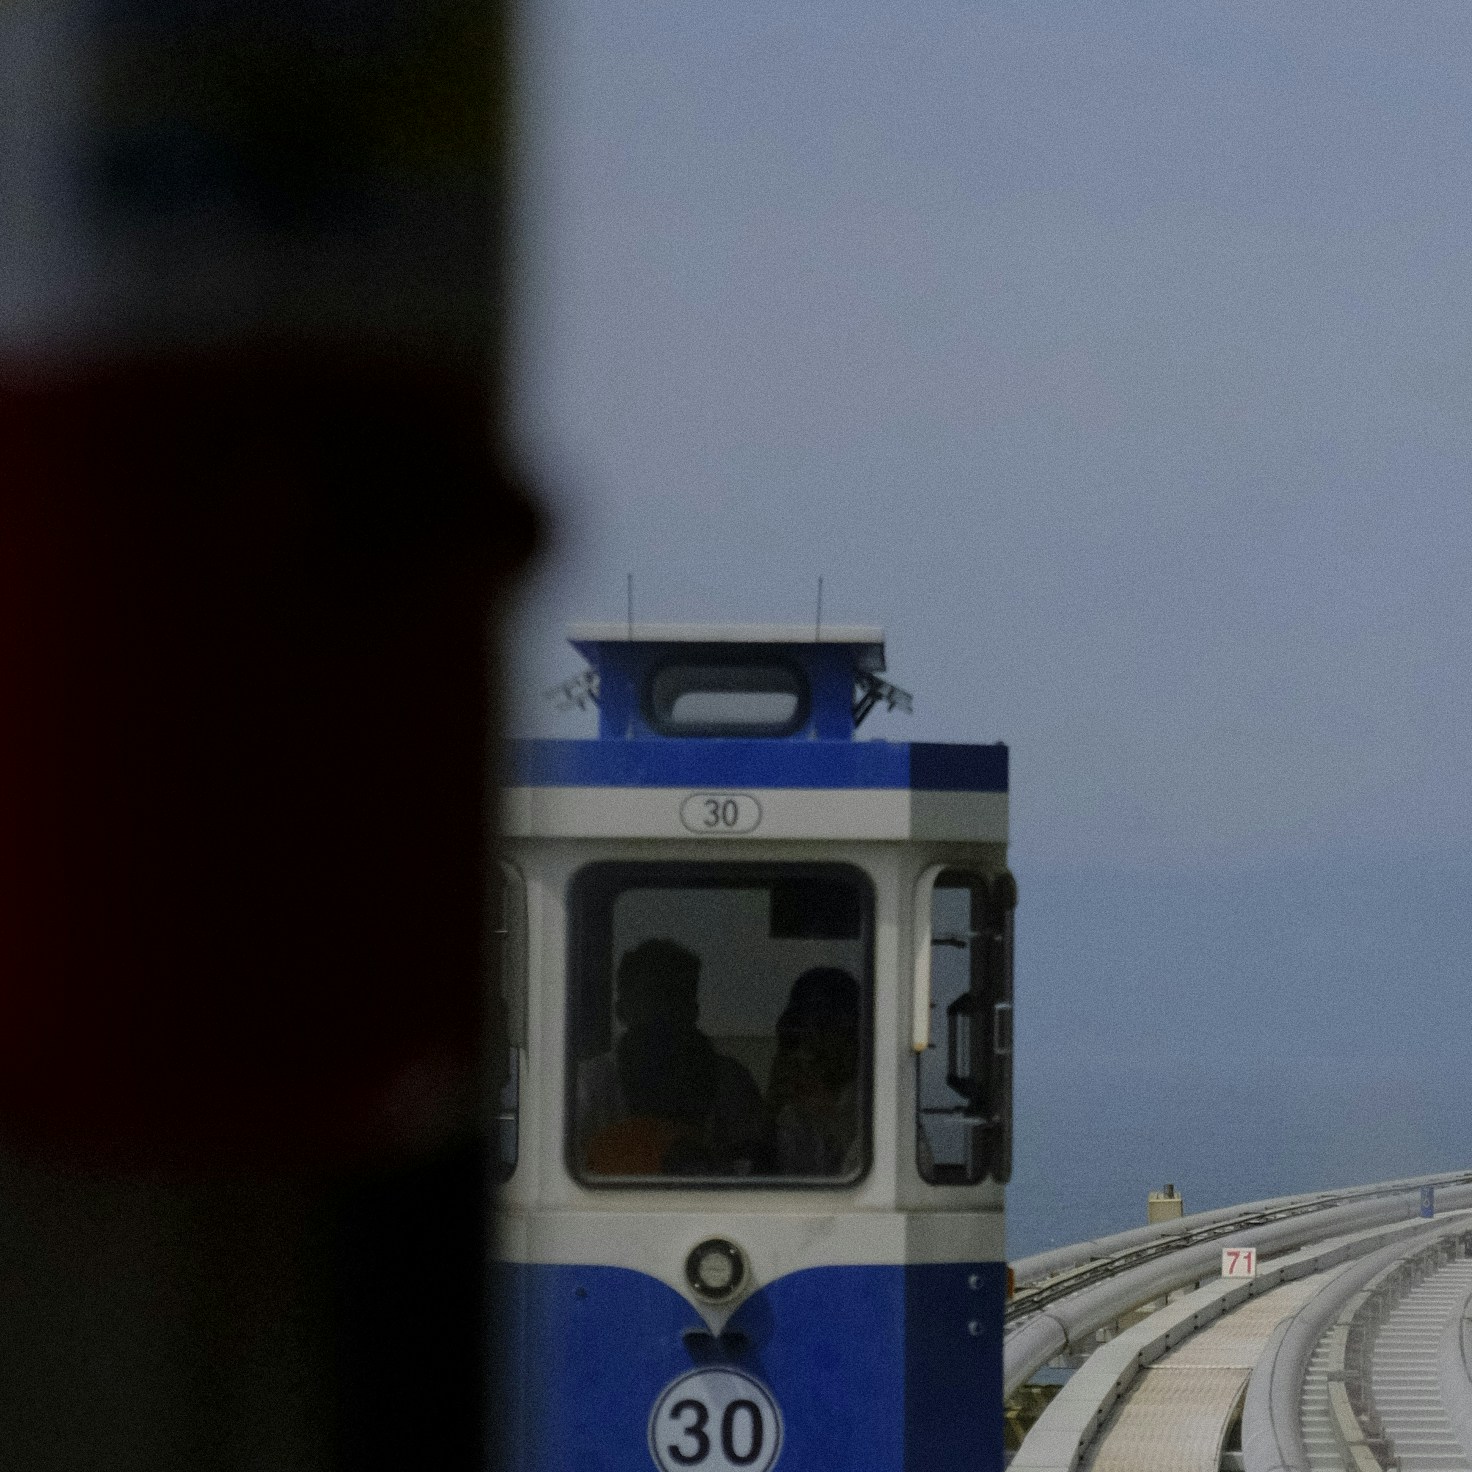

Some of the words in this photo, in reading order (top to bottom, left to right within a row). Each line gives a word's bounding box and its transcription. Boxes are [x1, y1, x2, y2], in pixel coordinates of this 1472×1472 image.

[704, 799, 738, 826] 30
[1227, 1251, 1251, 1274] 71
[668, 1399, 763, 1466] 30
